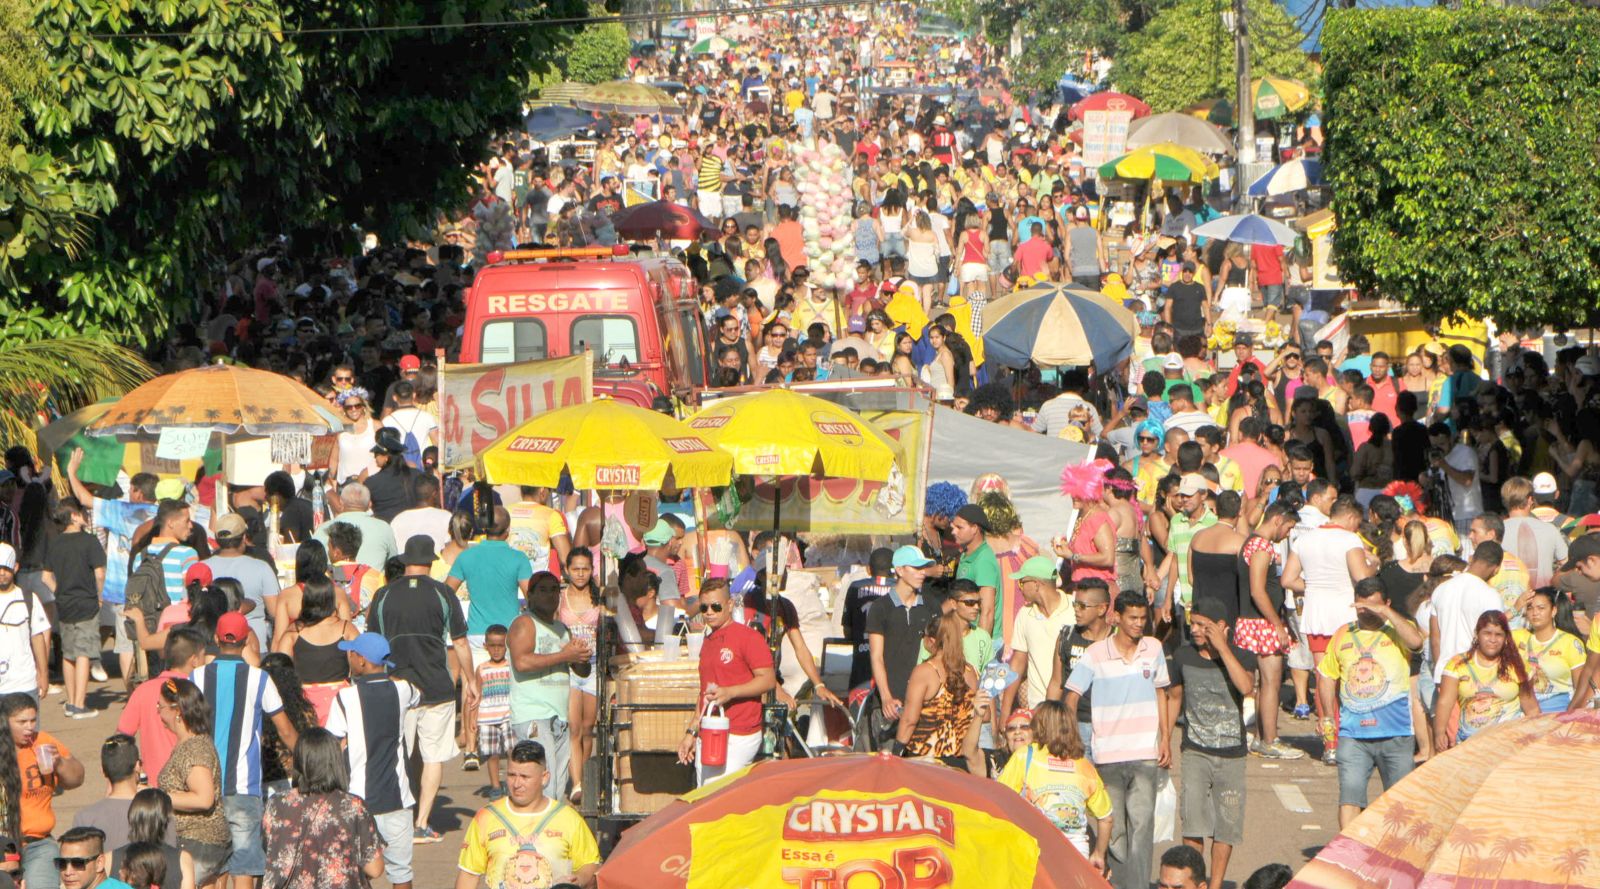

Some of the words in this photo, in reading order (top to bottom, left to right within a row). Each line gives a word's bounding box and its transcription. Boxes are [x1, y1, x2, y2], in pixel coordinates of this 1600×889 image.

[488, 293, 629, 314] RESGATE
[510, 437, 560, 452] CRYSTAL
[666, 438, 709, 451] CRYSTAL
[596, 467, 638, 483] CRYSTAL
[788, 800, 941, 833] CRYSTAL
[782, 848, 821, 862] Essa
[825, 850, 835, 862] é
[782, 847, 953, 889] TOP
